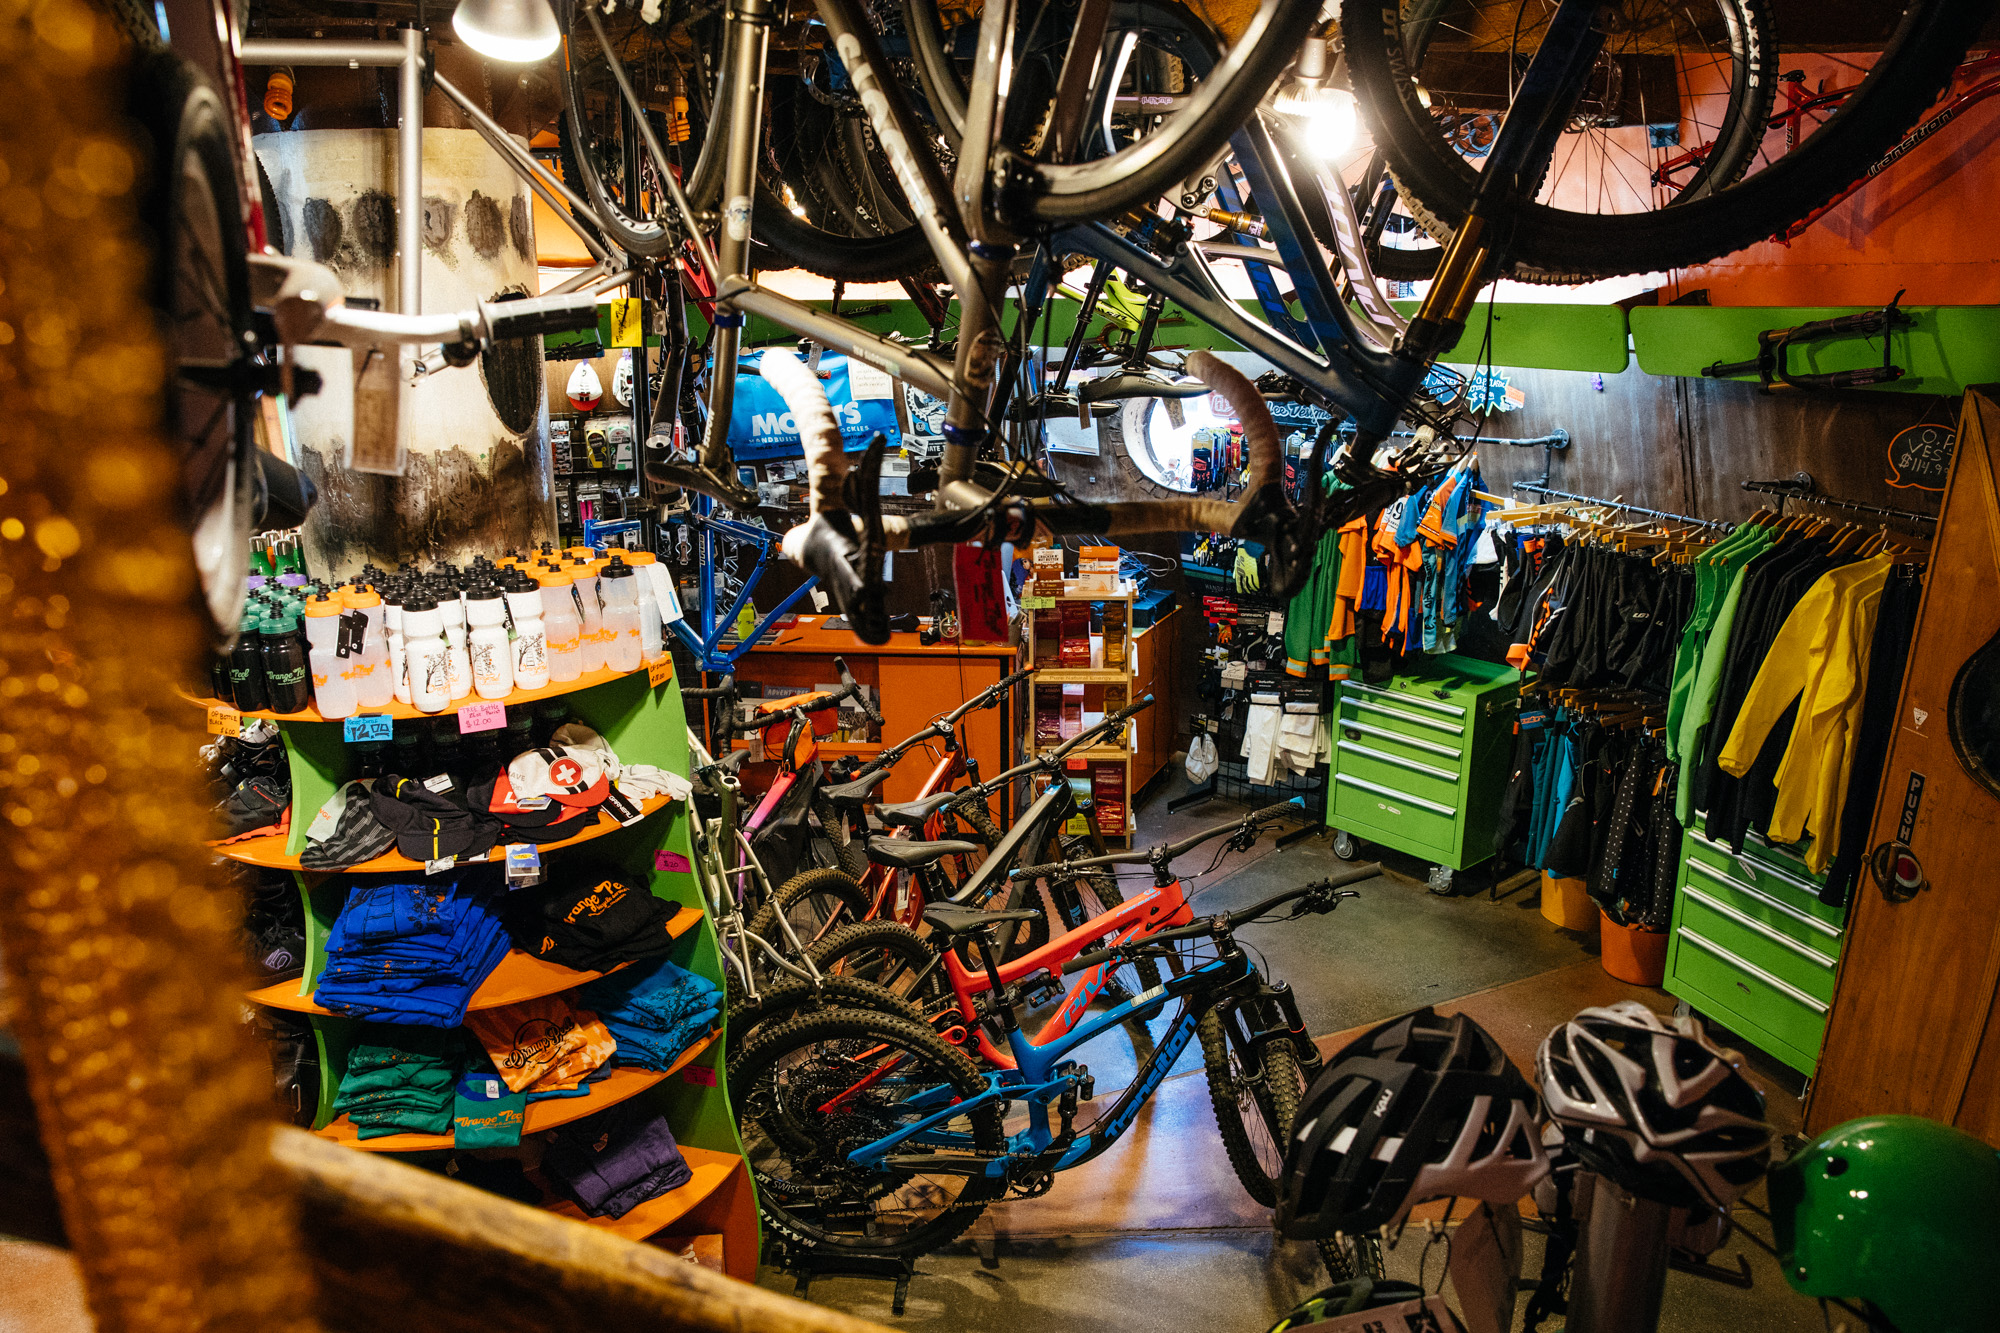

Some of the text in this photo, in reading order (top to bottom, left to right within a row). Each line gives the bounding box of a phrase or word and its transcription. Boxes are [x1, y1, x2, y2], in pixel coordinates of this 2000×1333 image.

[1737, 0, 1761, 88] AXXIS
[861, 117, 875, 151] 700
[1316, 171, 1397, 327] PIVOT
[752, 400, 862, 437] MOTS
[1900, 777, 1921, 841] PUSH
[1105, 1013, 1198, 1139] Transition
[454, 1116, 498, 1128] Orange
[756, 1172, 800, 1195] DT SWISS
[759, 1208, 817, 1248] MAXXIS
